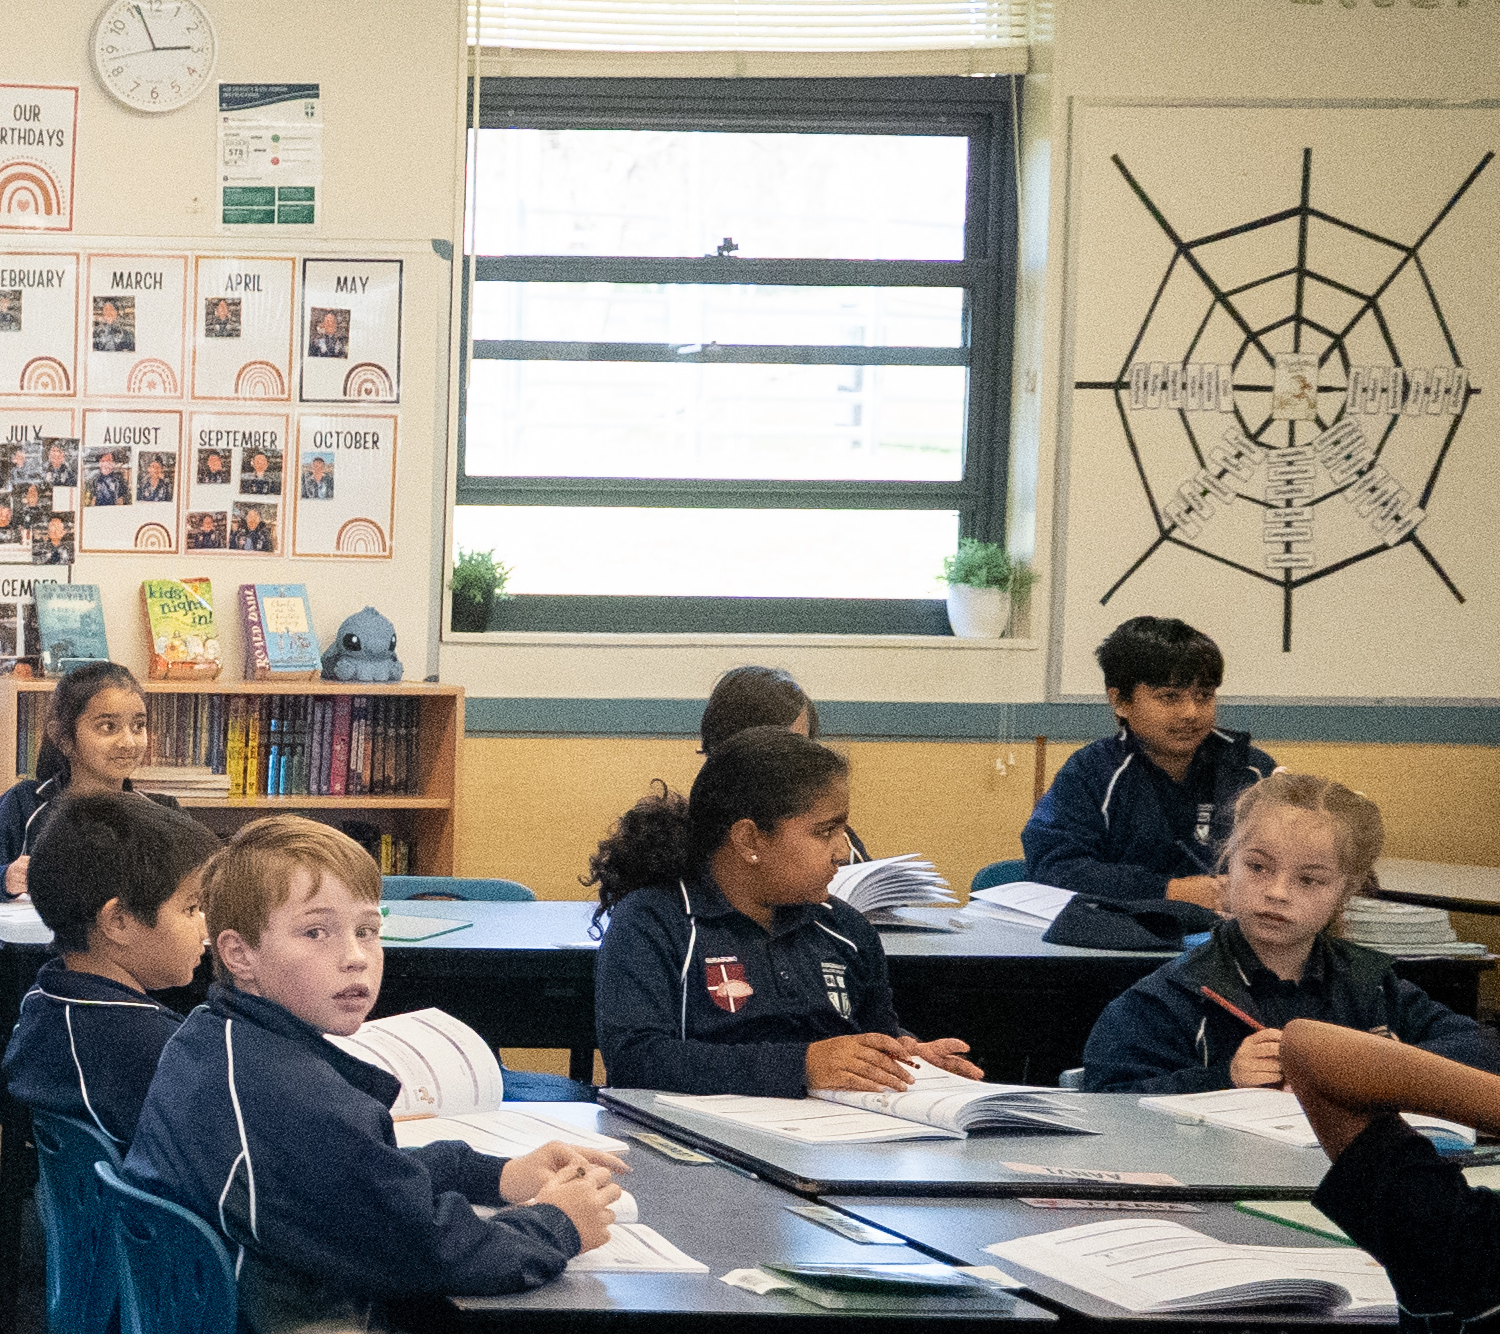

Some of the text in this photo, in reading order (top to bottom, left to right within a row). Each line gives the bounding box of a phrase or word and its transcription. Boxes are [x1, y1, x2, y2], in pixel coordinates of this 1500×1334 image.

[147, 0, 162, 13] 12
[110, 19, 126, 35] 10
[186, 22, 199, 34] 2
[105, 44, 119, 54] 9
[111, 65, 124, 78] 8
[130, 80, 141, 92] 7
[150, 86, 159, 100] 6
[13, 104, 41, 122] OUR
[111, 271, 163, 290] MARCH
[225, 273, 263, 292] APRIL
[335, 275, 370, 294] MAY
[103, 426, 161, 445] AUGUST
[199, 430, 278, 449] SEPTEMBER
[313, 431, 380, 450] OCTOBER
[191, 611, 213, 625] in!
[244, 588, 270, 669] ROALD DAHL
